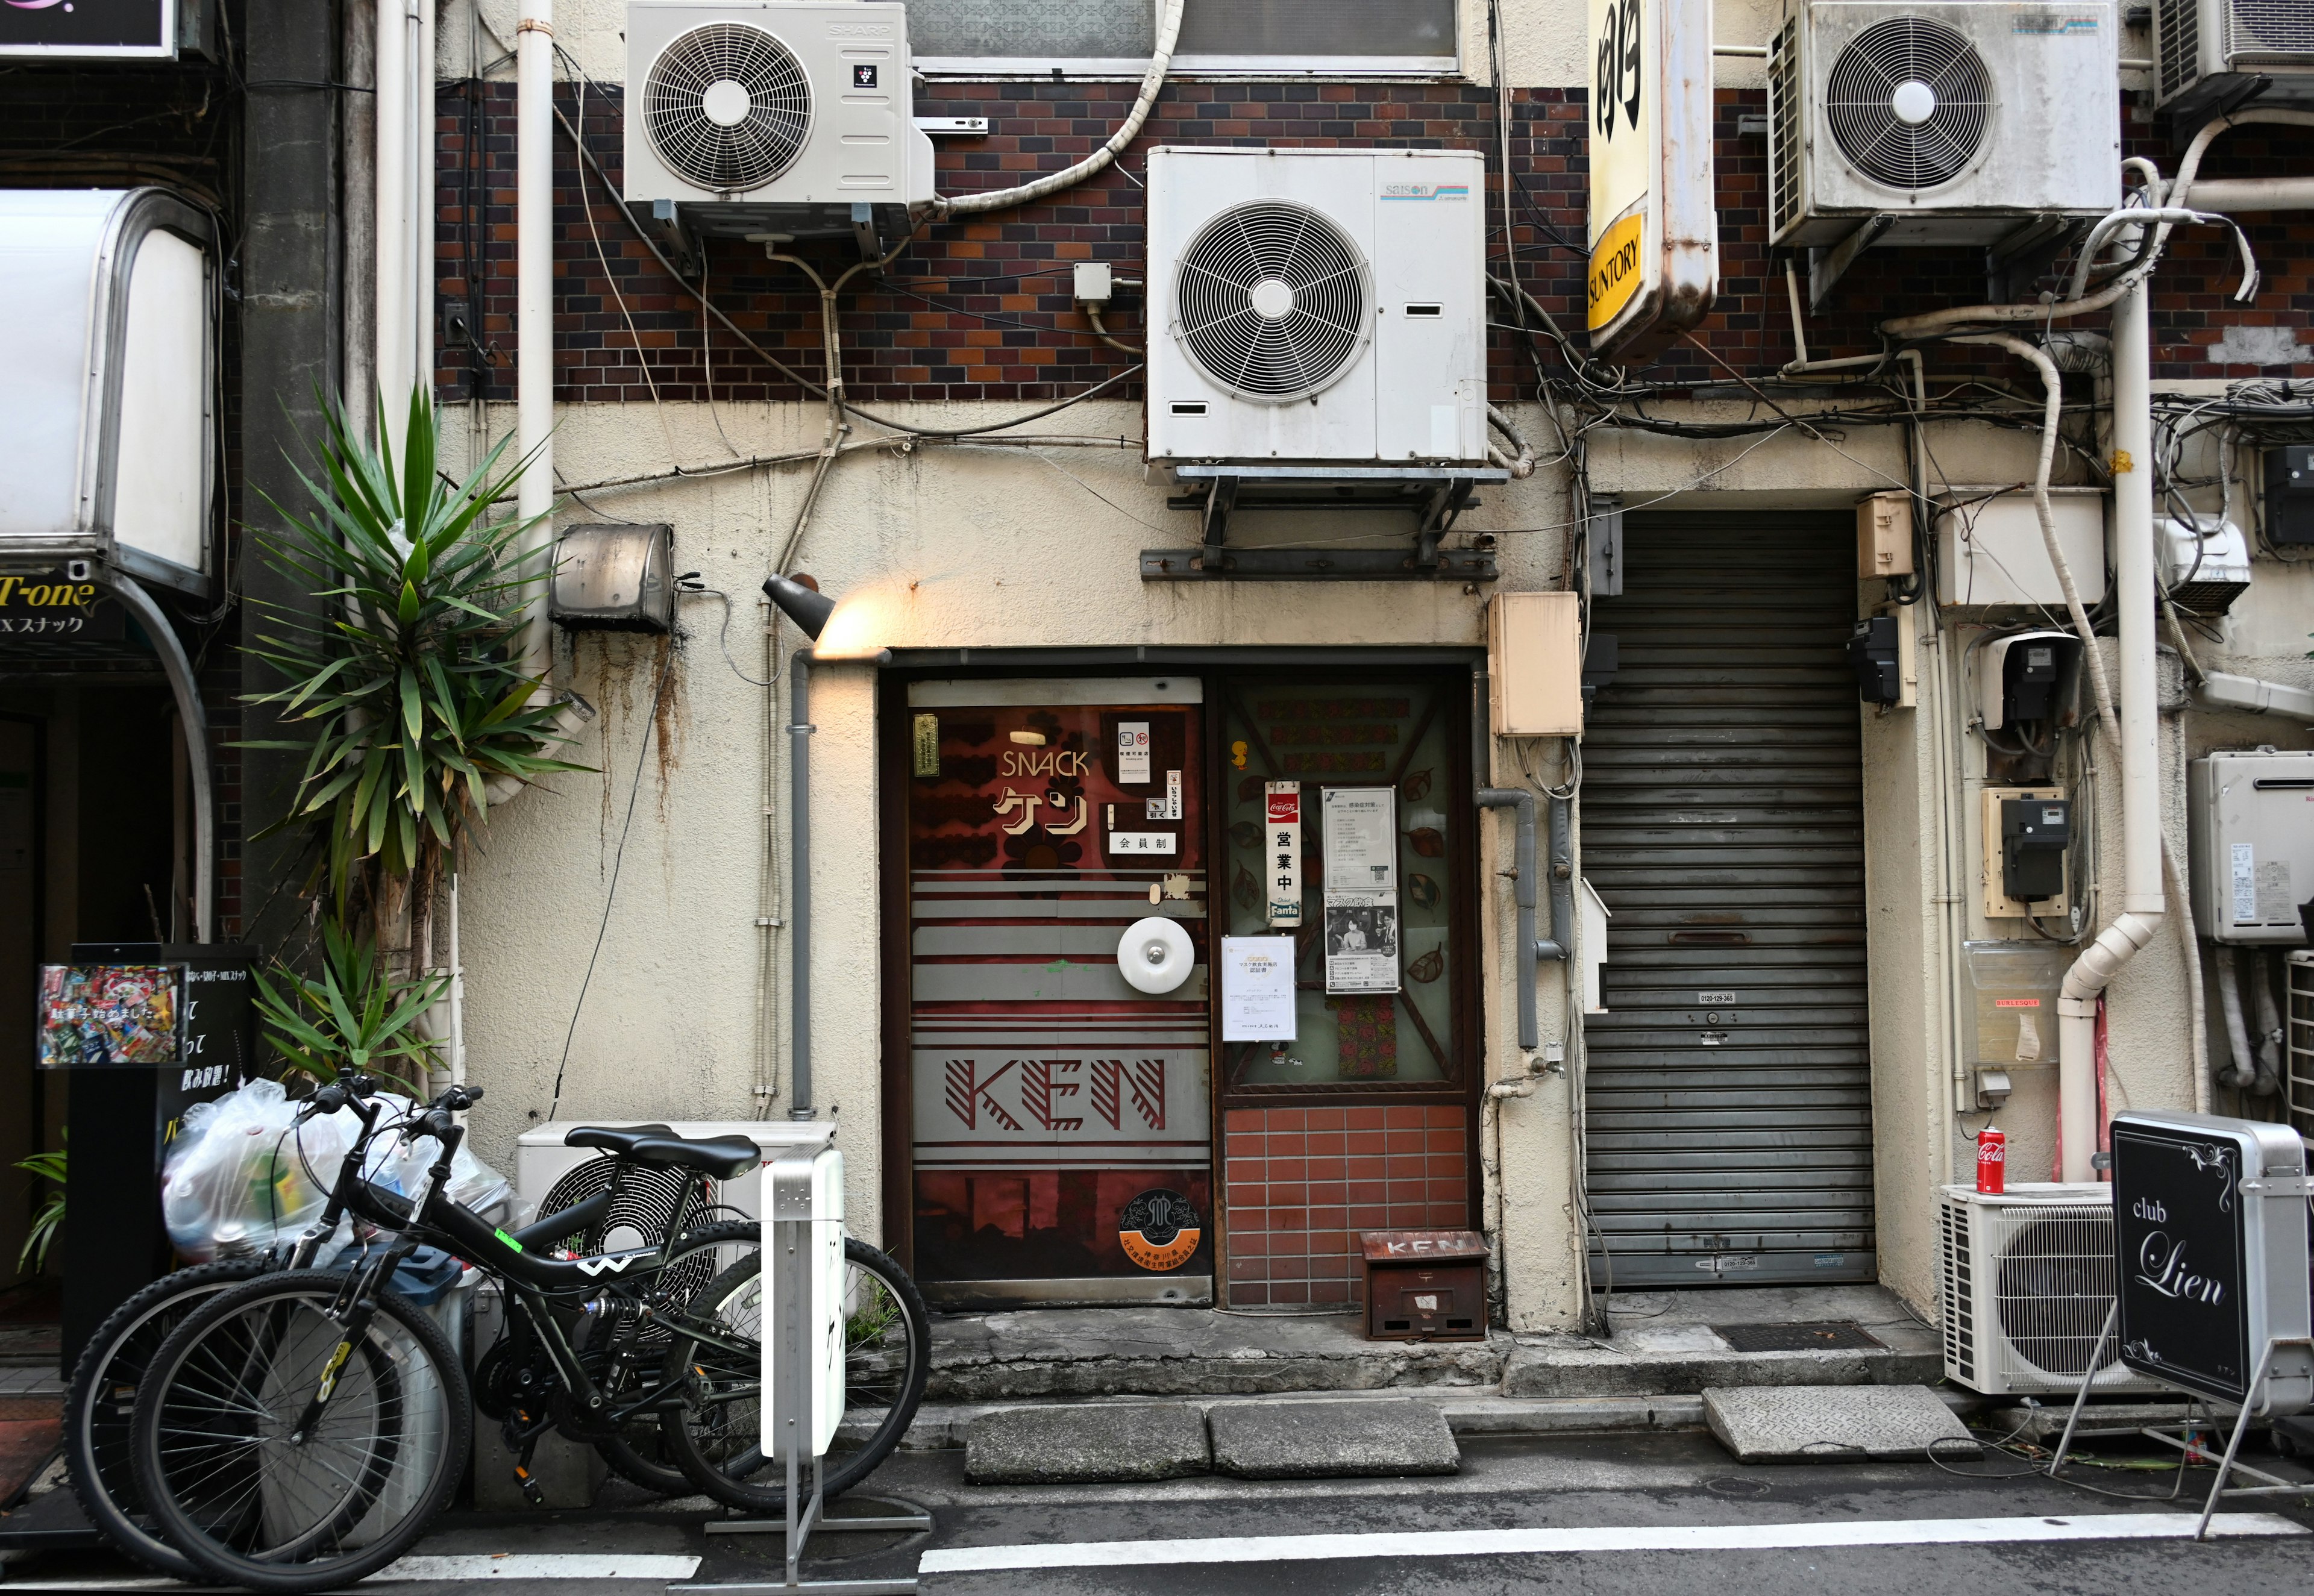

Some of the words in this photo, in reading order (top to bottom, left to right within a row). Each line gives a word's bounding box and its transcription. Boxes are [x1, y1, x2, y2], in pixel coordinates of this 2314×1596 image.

[829, 25, 891, 36] SHARP
[1385, 185, 1428, 195] saison
[1589, 234, 1639, 308] SUNTORY
[1002, 751, 1090, 777] SNACK
[993, 787, 1087, 835] ケン
[1119, 837, 1167, 849] 会員制
[1276, 831, 1292, 891] 営業中
[1271, 906, 1298, 916] Fanta
[1327, 898, 1374, 907] マスク飲食
[945, 1059, 1165, 1130] KEN
[2133, 1197, 2167, 1223] club
[1143, 1248, 1179, 1262] 神奈川県
[1387, 1239, 1465, 1254] KEN
[2134, 1230, 2227, 1306] Lien
